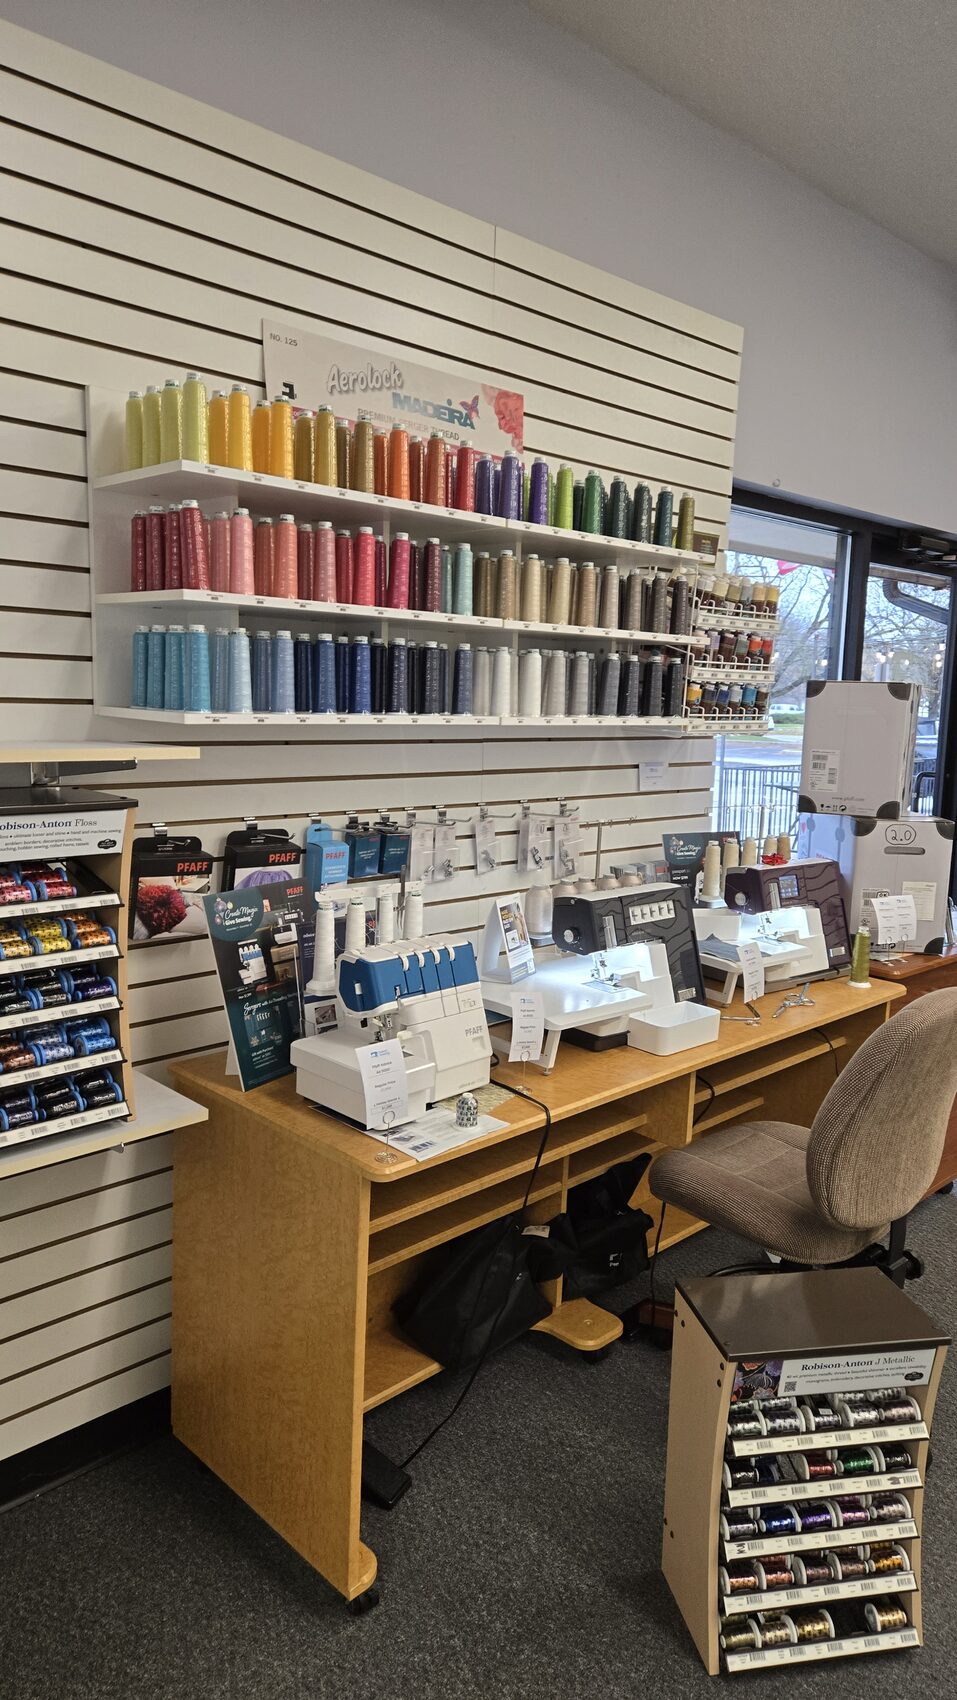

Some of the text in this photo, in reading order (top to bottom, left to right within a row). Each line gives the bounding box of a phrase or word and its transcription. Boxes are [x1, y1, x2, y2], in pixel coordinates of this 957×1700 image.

[269, 332, 299, 347] NO. 125
[326, 361, 404, 394] Aerolock
[391, 391, 476, 430] MADEIRA
[357, 407, 398, 424] PREMIUM
[430, 425, 460, 441] THREAD
[0, 818, 98, 831] obison-Anton Floss
[890, 829, 912, 842] 2.0
[268, 852, 298, 864] PFAFF
[325, 851, 346, 860] PFAFF
[176, 861, 209, 873] PFAFF
[286, 886, 304, 896] PFAFF
[464, 1025, 483, 1038] PFAFF
[801, 1359, 873, 1372] Robison-Anton
[881, 1355, 916, 1365] Metallic
